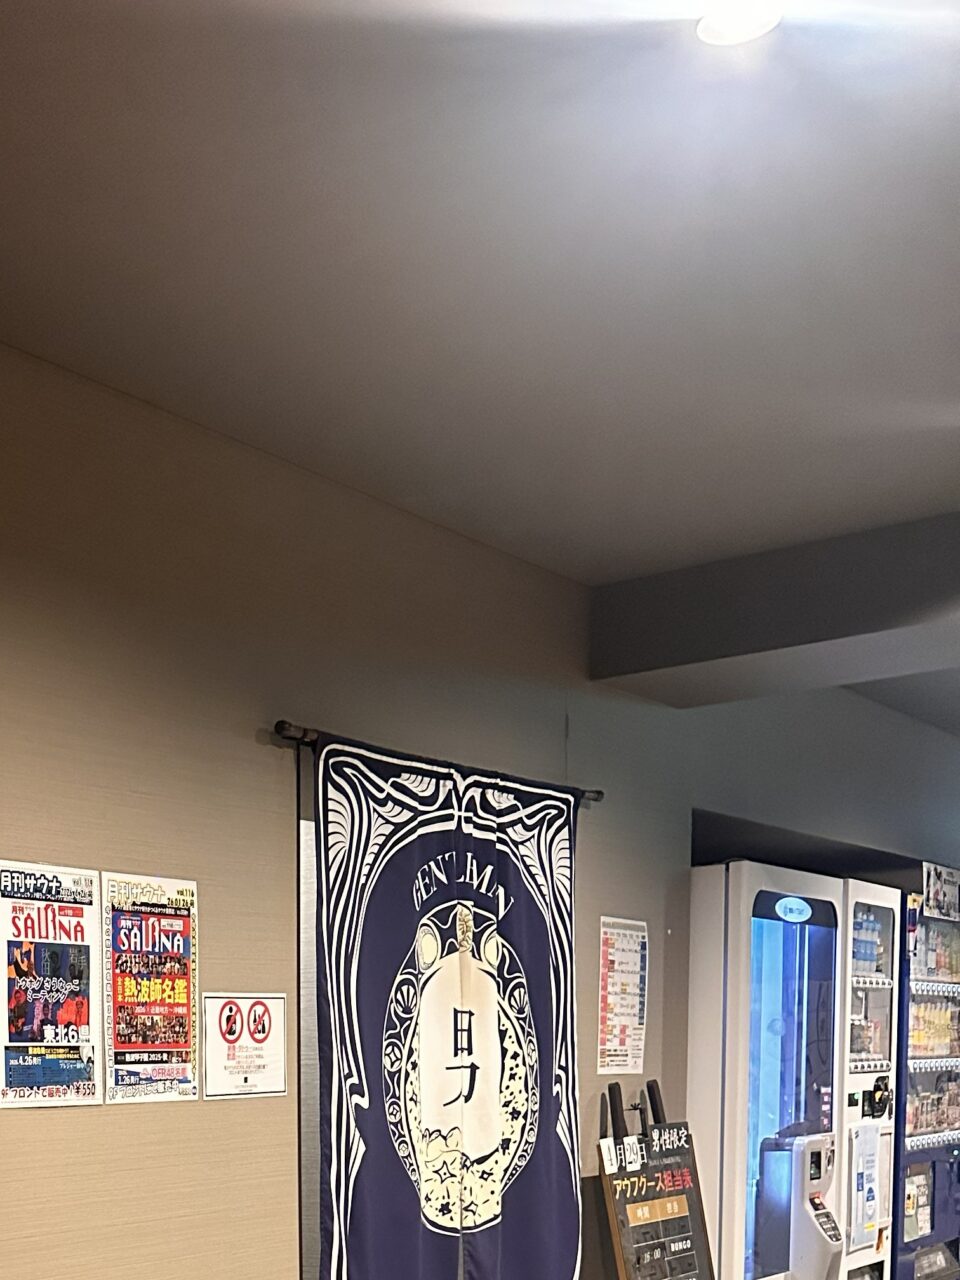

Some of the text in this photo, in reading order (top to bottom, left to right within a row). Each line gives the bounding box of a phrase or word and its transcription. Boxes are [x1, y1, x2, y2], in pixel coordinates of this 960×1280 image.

[0, 870, 61, 896] 月刊サウナ
[107, 880, 166, 903] 月刊サウナ
[652, 1126, 690, 1152] 男性限定
[613, 1167, 694, 1200] アウフグース担当表
